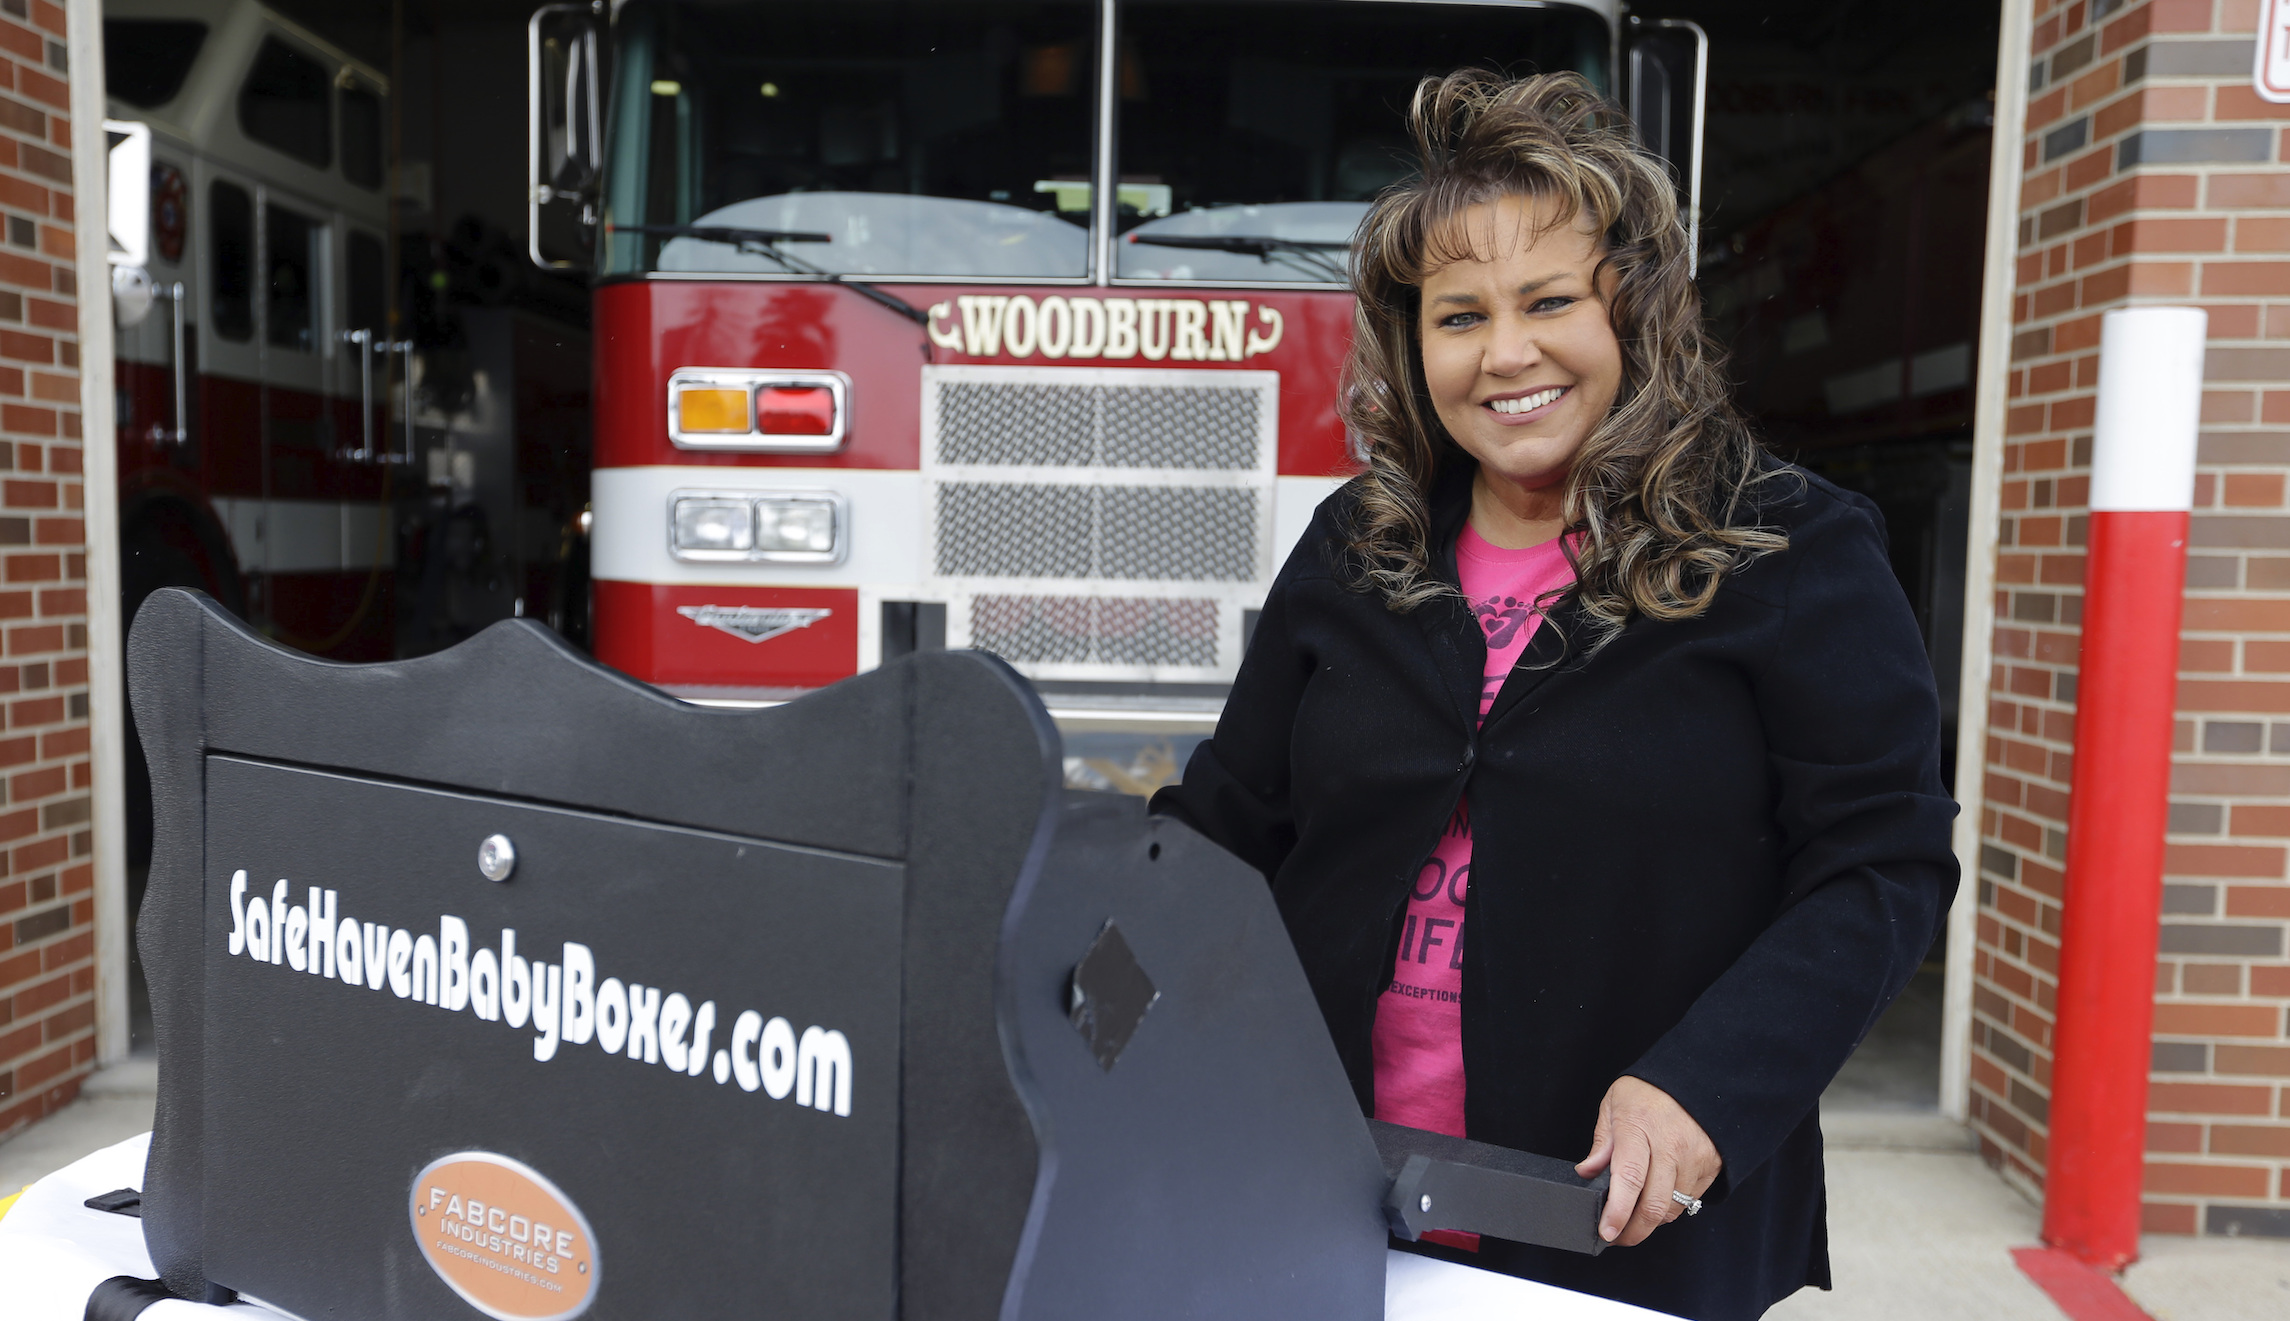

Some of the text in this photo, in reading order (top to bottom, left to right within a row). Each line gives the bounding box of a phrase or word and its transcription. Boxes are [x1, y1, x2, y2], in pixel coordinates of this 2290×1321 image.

[957, 295, 1249, 361] WOODBURN
[228, 869, 852, 1118] SafeHavenBabyBoxes.com
[429, 1186, 575, 1260] FABCORE
[440, 1217, 560, 1275] INDUSTRIES
[436, 1240, 563, 1294] FABCOREINDUSTRIES.COM
